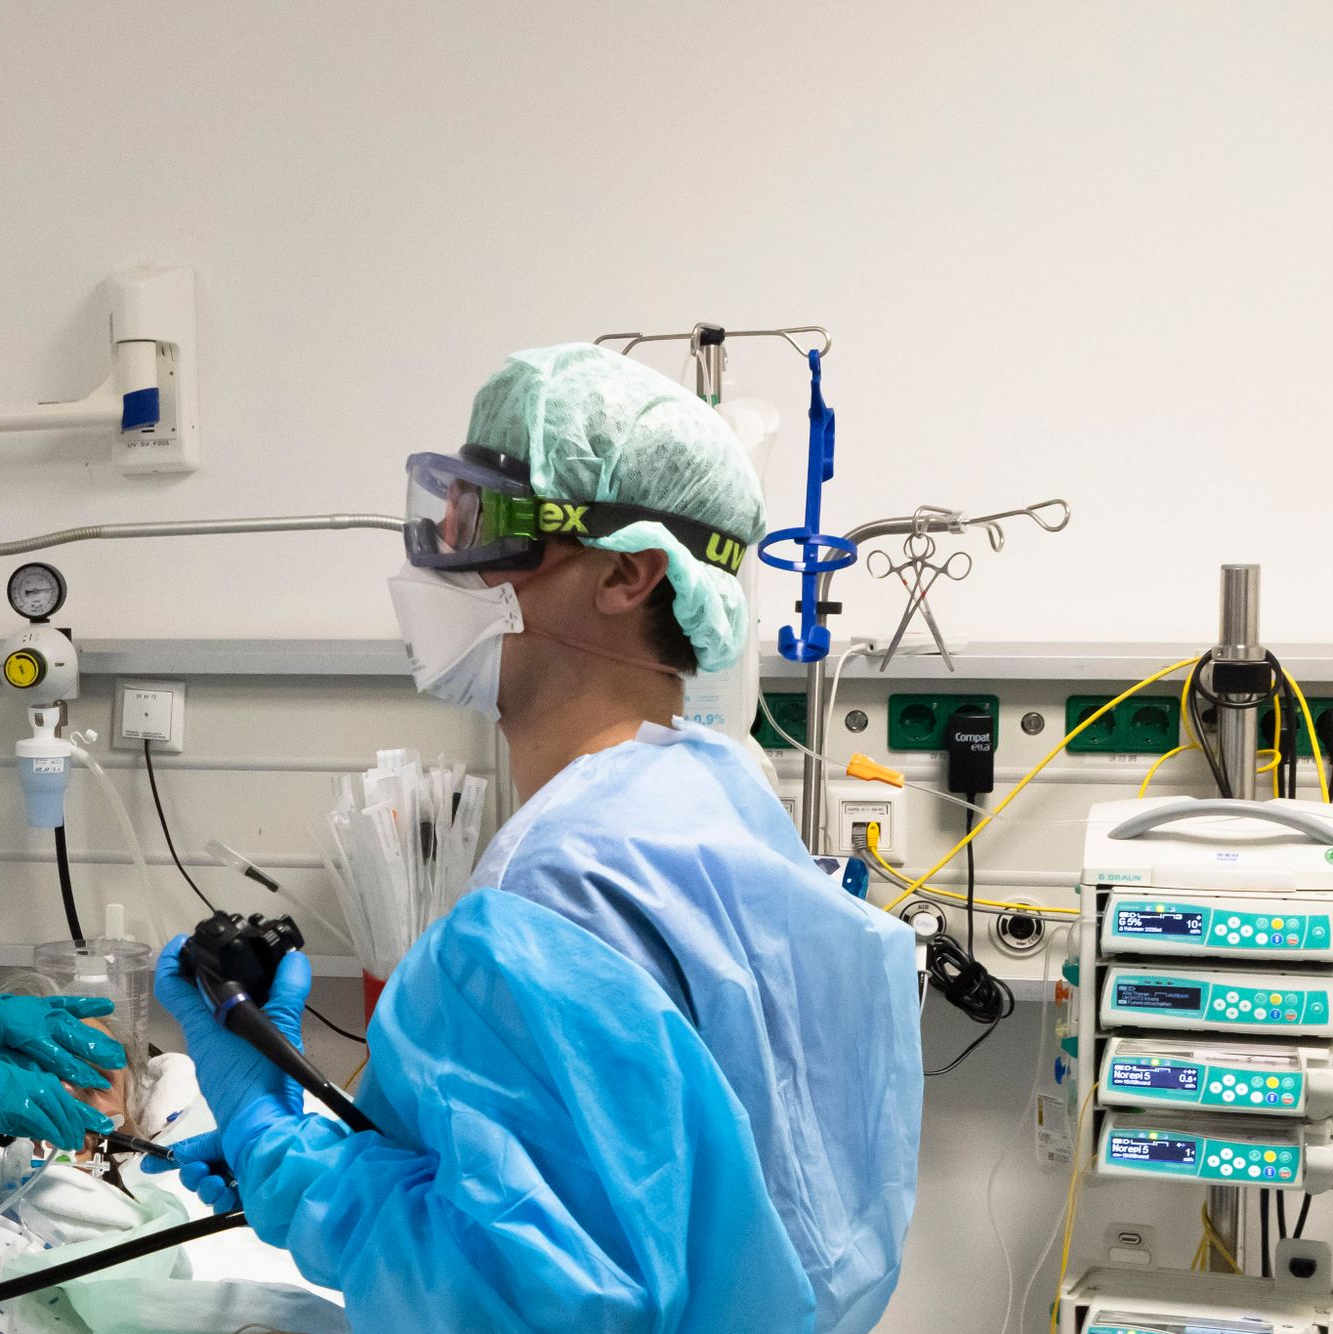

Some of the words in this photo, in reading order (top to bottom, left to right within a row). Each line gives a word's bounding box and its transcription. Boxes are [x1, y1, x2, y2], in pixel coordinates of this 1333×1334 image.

[705, 533, 746, 570] uv
[955, 732, 990, 744] Compat
[1108, 873, 1141, 882] BRAUN
[1186, 919, 1198, 929] 10
[1113, 1070, 1143, 1080] Norepi
[1144, 1072, 1151, 1080] 5
[1112, 1144, 1141, 1154] Norepi
[1142, 1145, 1149, 1154] 5
[1185, 1148, 1191, 1157] 1
